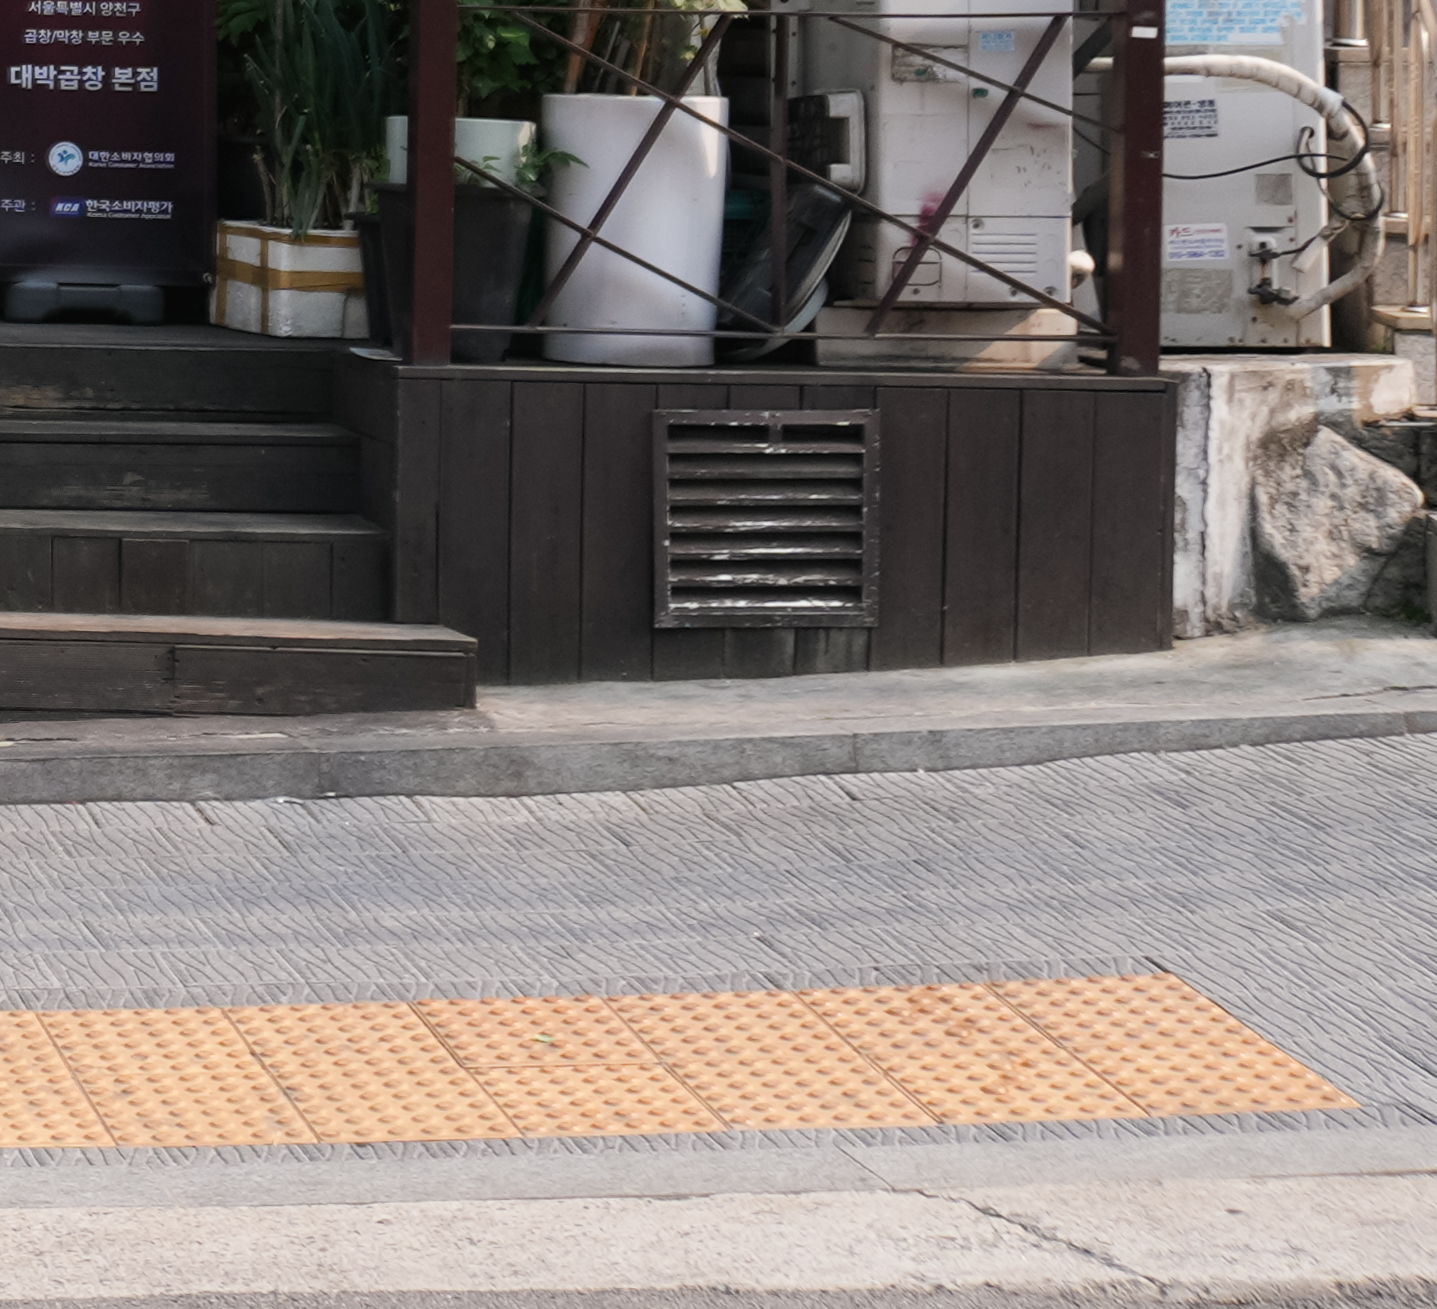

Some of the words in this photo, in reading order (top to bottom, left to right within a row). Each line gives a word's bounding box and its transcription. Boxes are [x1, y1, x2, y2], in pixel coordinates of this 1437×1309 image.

[28, 0, 97, 17] 서울특별시
[100, 1, 142, 18] 양천구
[24, 29, 84, 46] 곱창/막창
[86, 30, 114, 45] 부문
[117, 30, 145, 46] 우수
[9, 64, 106, 92] 대박곱창
[111, 65, 160, 92] 본점
